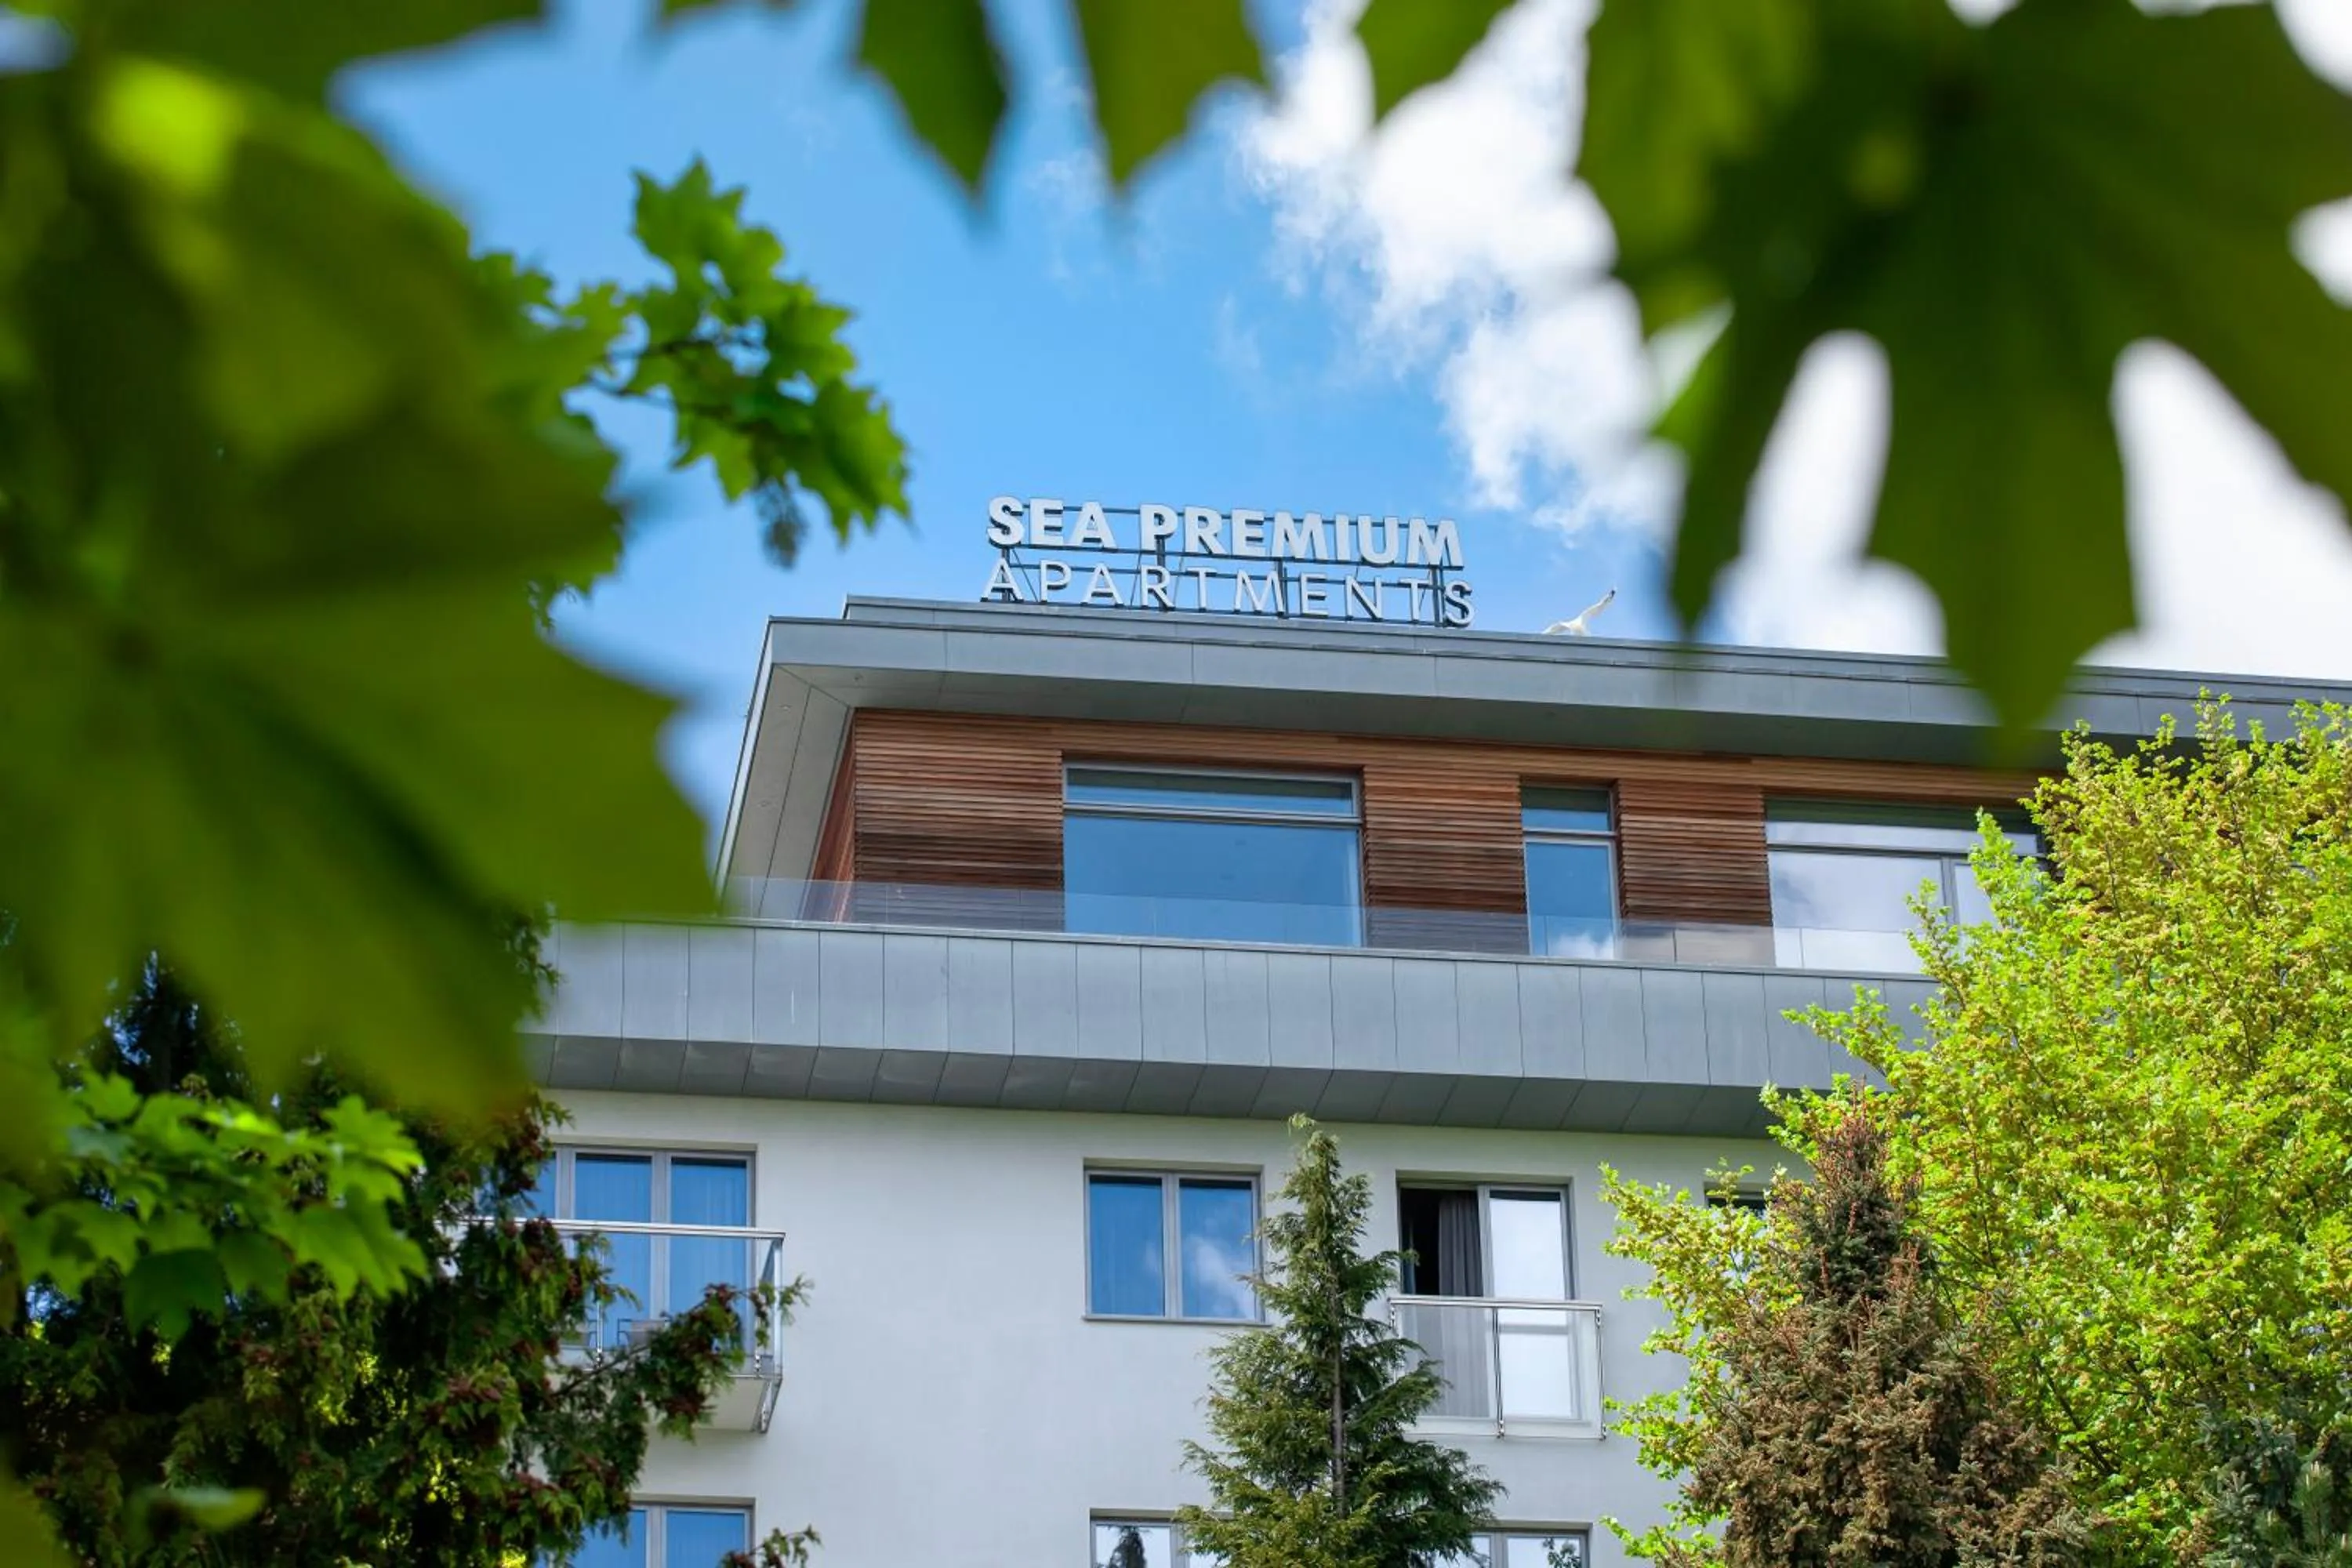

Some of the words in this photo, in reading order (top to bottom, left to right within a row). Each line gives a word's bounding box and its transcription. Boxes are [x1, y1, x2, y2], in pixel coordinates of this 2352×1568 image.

[987, 495, 1116, 548] SEA
[1139, 503, 1464, 570] PREMIUM
[980, 557, 1475, 626] APARTMENTS
